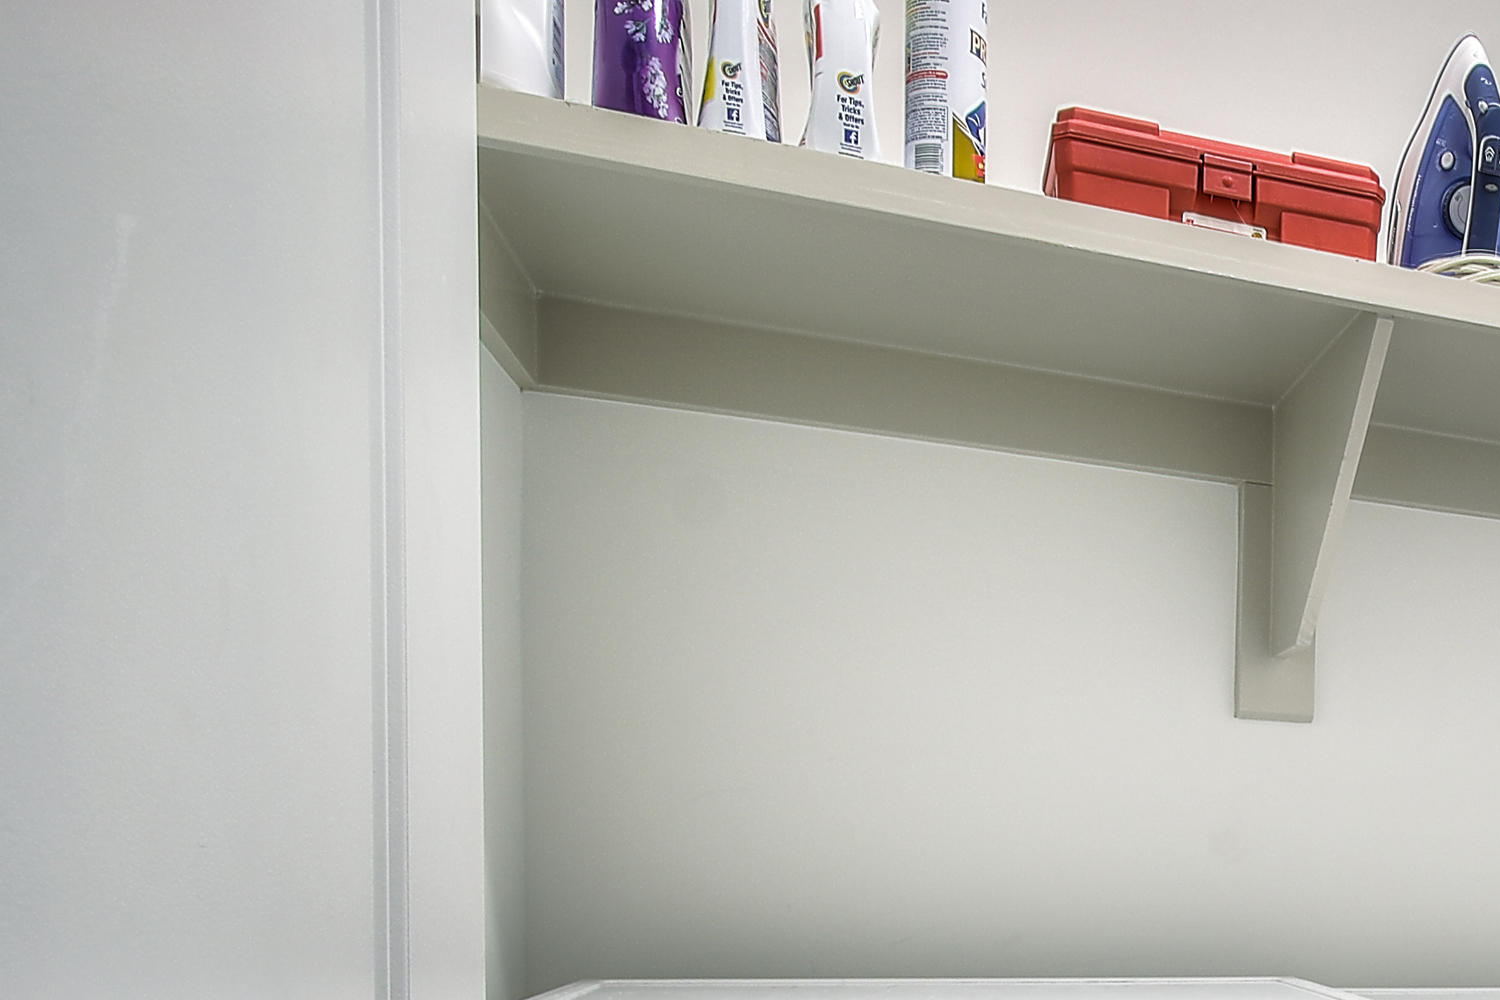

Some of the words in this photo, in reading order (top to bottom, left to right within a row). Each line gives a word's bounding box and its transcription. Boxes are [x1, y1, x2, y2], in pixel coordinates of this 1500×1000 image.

[725, 88, 741, 96] Tricks
[836, 94, 848, 103] For
[841, 104, 861, 115] Tricks
[844, 113, 865, 125] Offers
